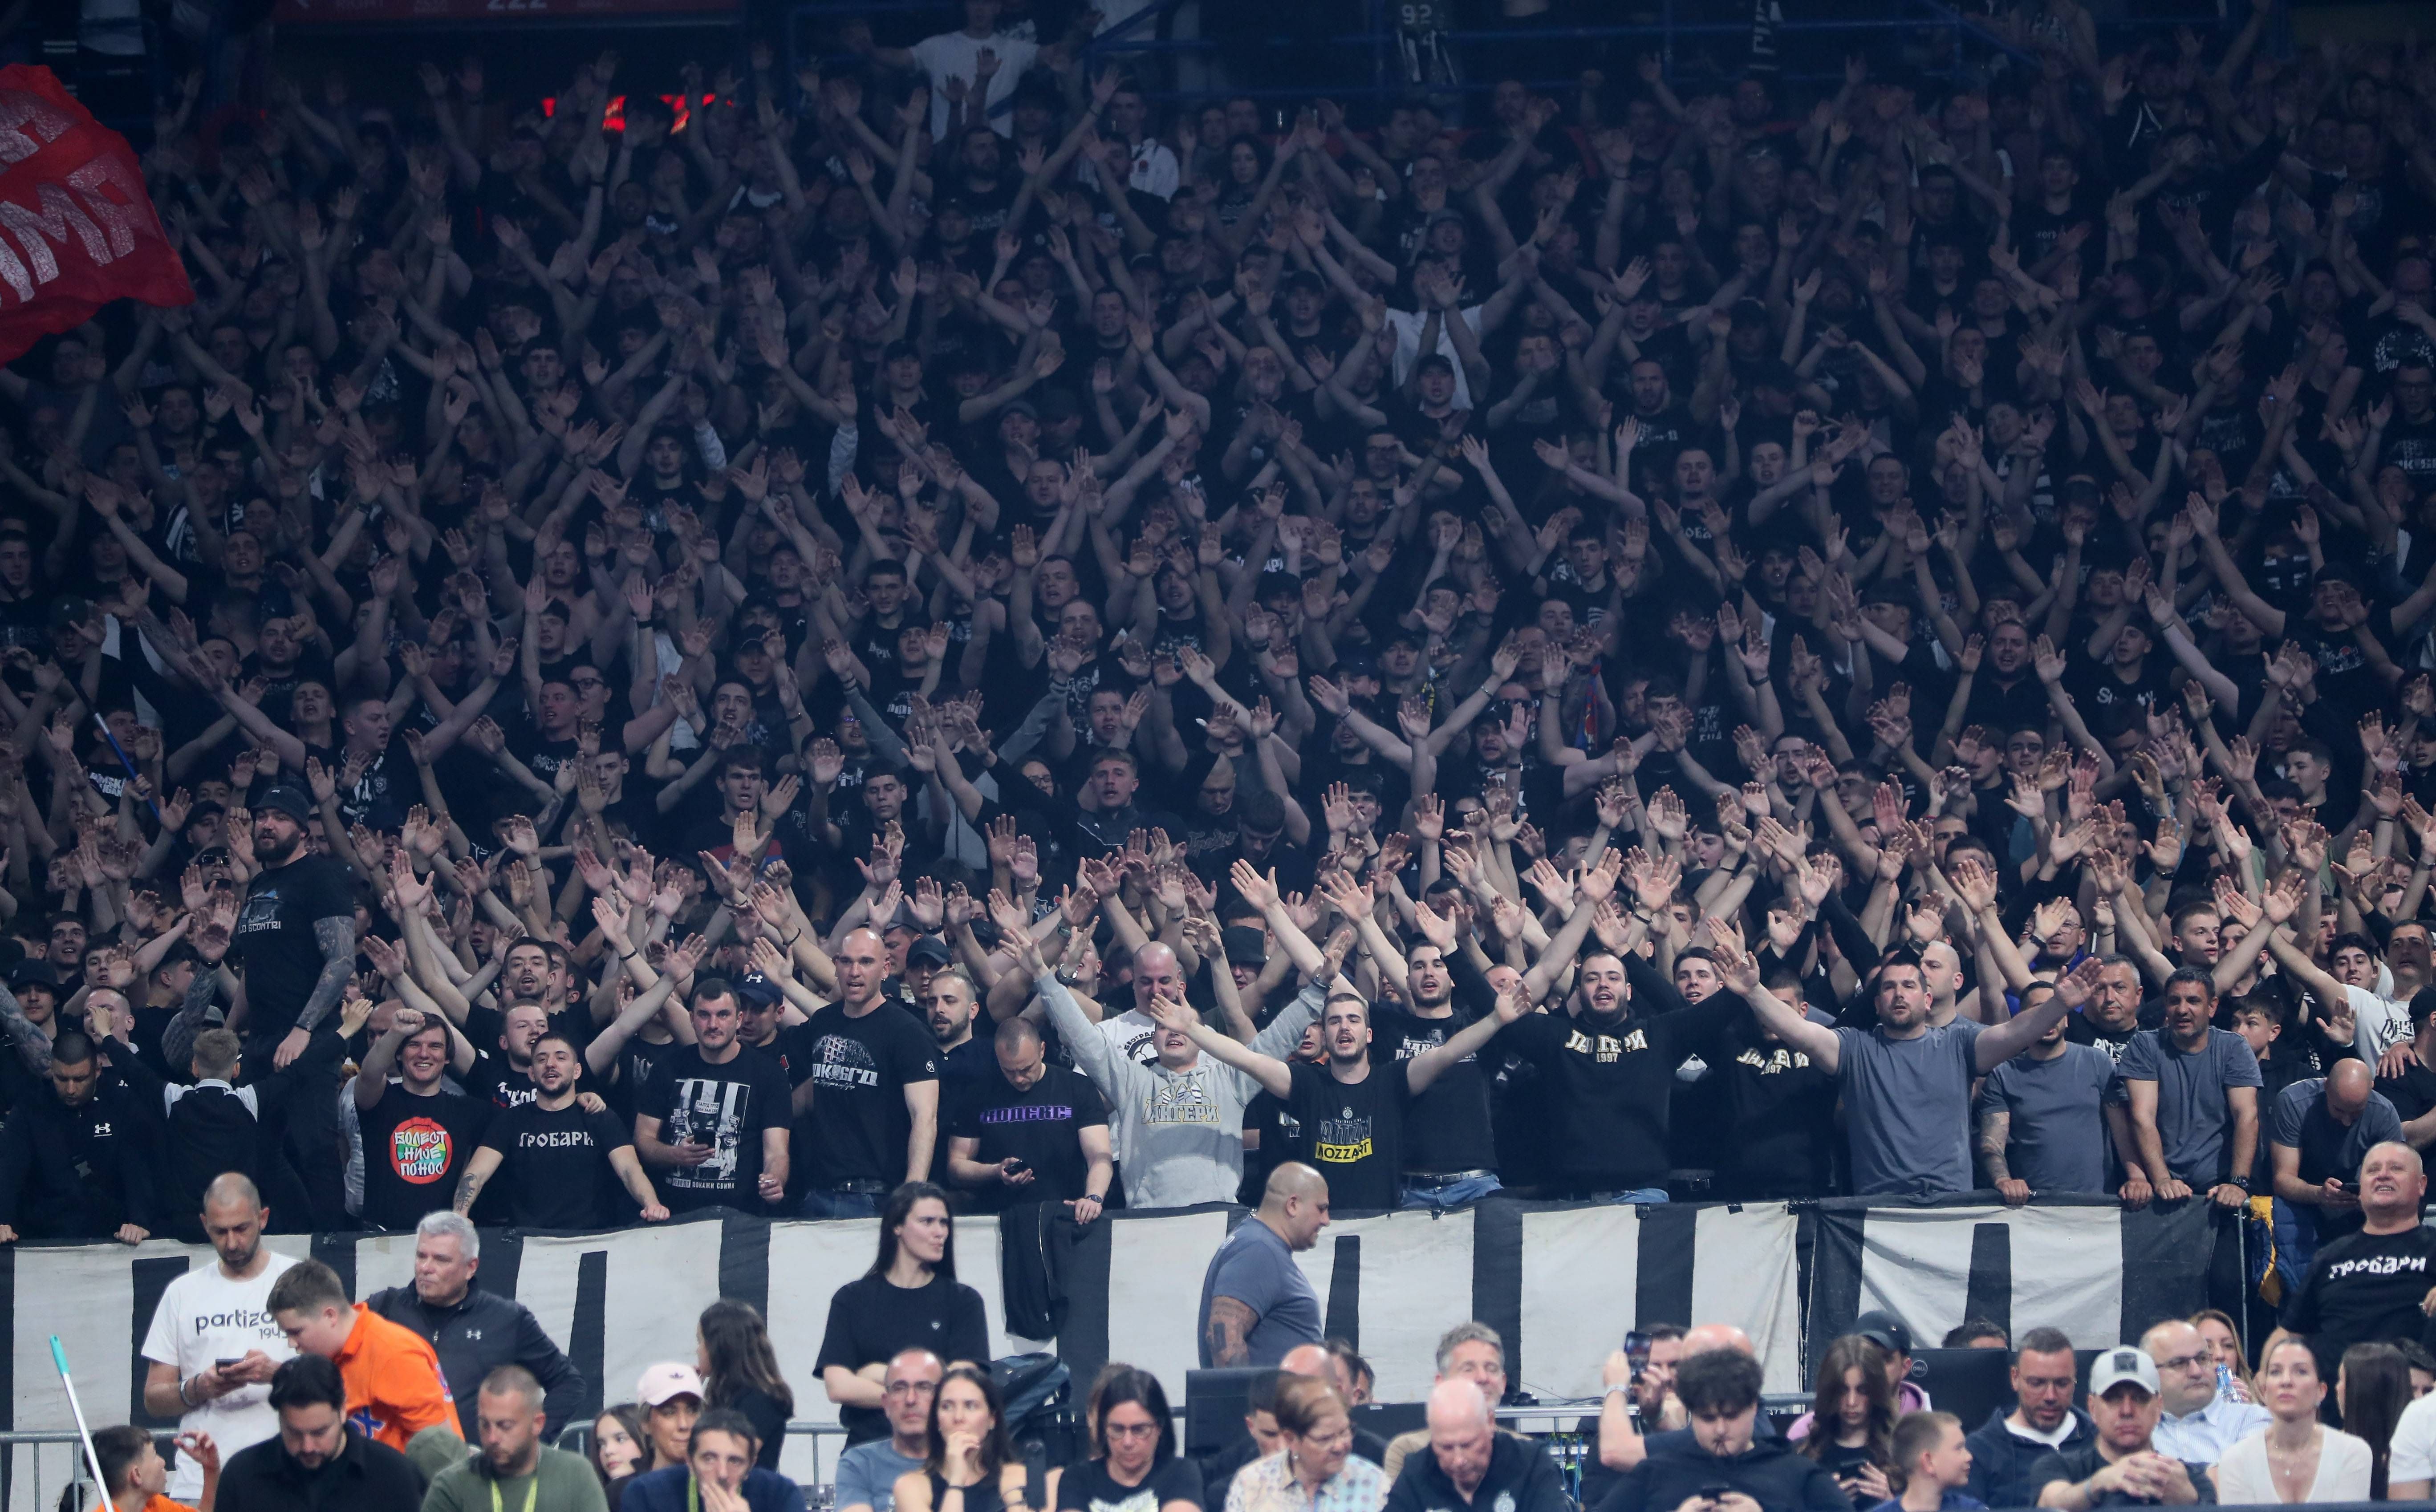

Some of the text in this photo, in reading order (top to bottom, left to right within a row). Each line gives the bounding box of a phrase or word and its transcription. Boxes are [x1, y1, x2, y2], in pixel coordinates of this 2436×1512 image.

[1401, 4, 1433, 25] 92
[248, 921, 281, 932] SCONTRI
[1596, 1052, 1619, 1063] 1997
[1141, 1099, 1220, 1125] ЈАНГЕРИ
[394, 1131, 447, 1146] БОЛЕСТ
[404, 1146, 441, 1161] НИЈЕ
[400, 1161, 444, 1176] ПОНОС
[692, 1181, 714, 1189] ПОКАЖИ
[196, 1309, 276, 1336] partiza
